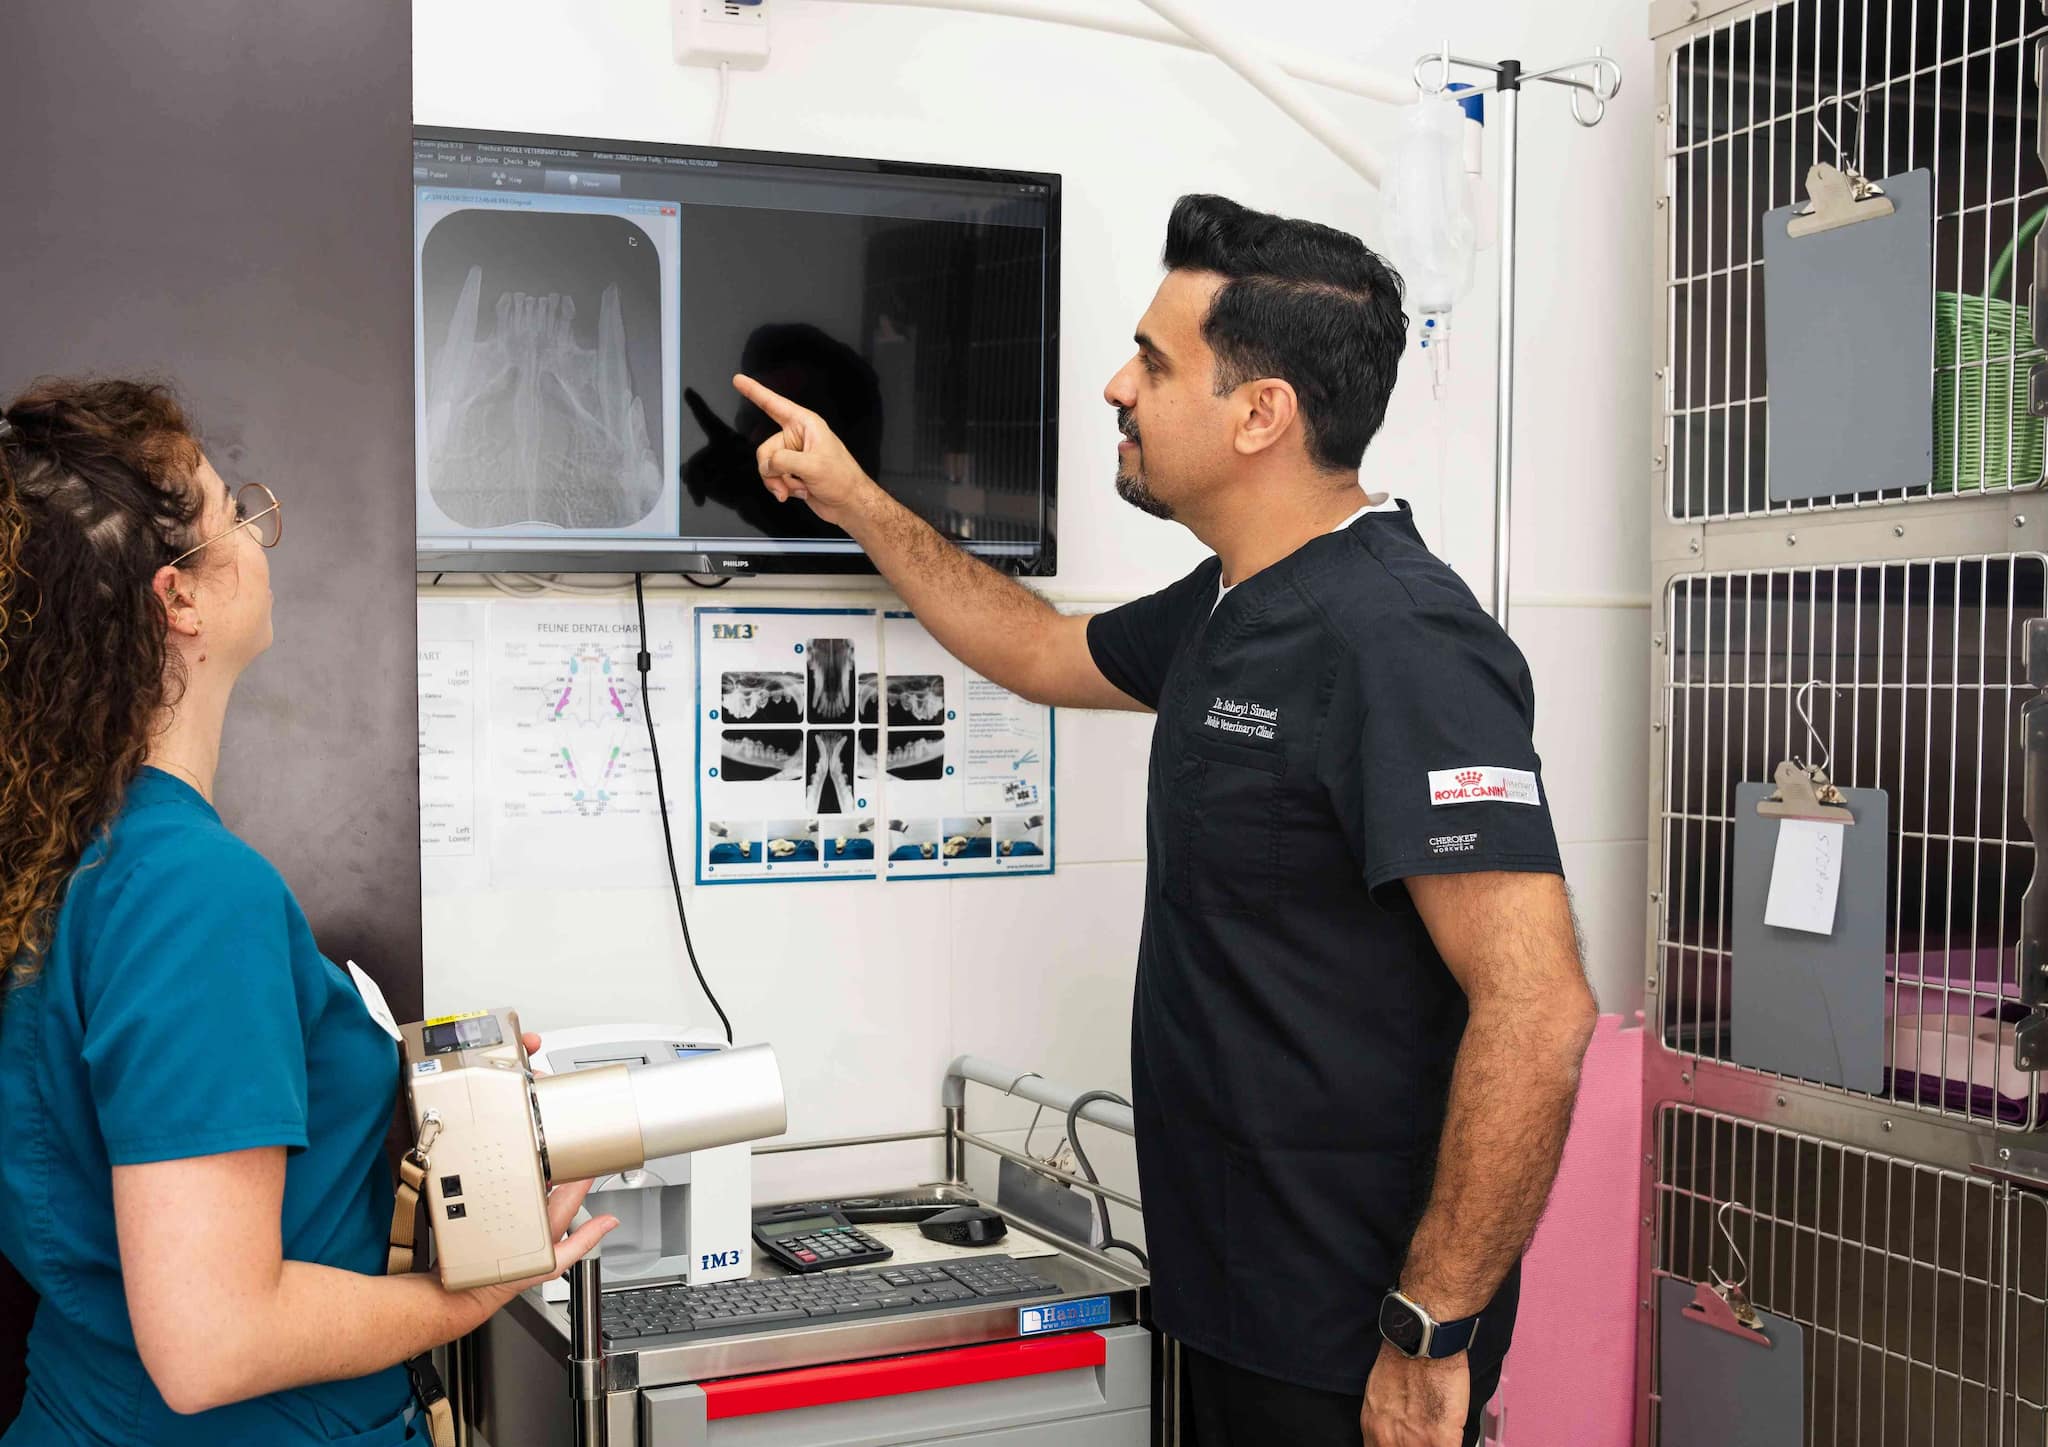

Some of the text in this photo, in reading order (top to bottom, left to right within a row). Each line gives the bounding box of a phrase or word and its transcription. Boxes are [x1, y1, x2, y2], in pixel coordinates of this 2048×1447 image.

[476, 155, 499, 164] Options
[722, 560, 749, 568] PHILIPS
[537, 623, 640, 633] FELINE DENTAL CHAR
[455, 669, 470, 678] Left
[447, 678, 470, 687] Upper
[1220, 719, 1255, 737] Veterinary
[1255, 725, 1275, 739] Clinic
[1434, 788, 1471, 800] ROYAL
[1471, 785, 1505, 798] CANIN
[455, 826, 470, 834] Left
[448, 835, 471, 843] Lower
[1428, 833, 1476, 846] CHEROKEE
[1432, 844, 1474, 853] WORKWEAR
